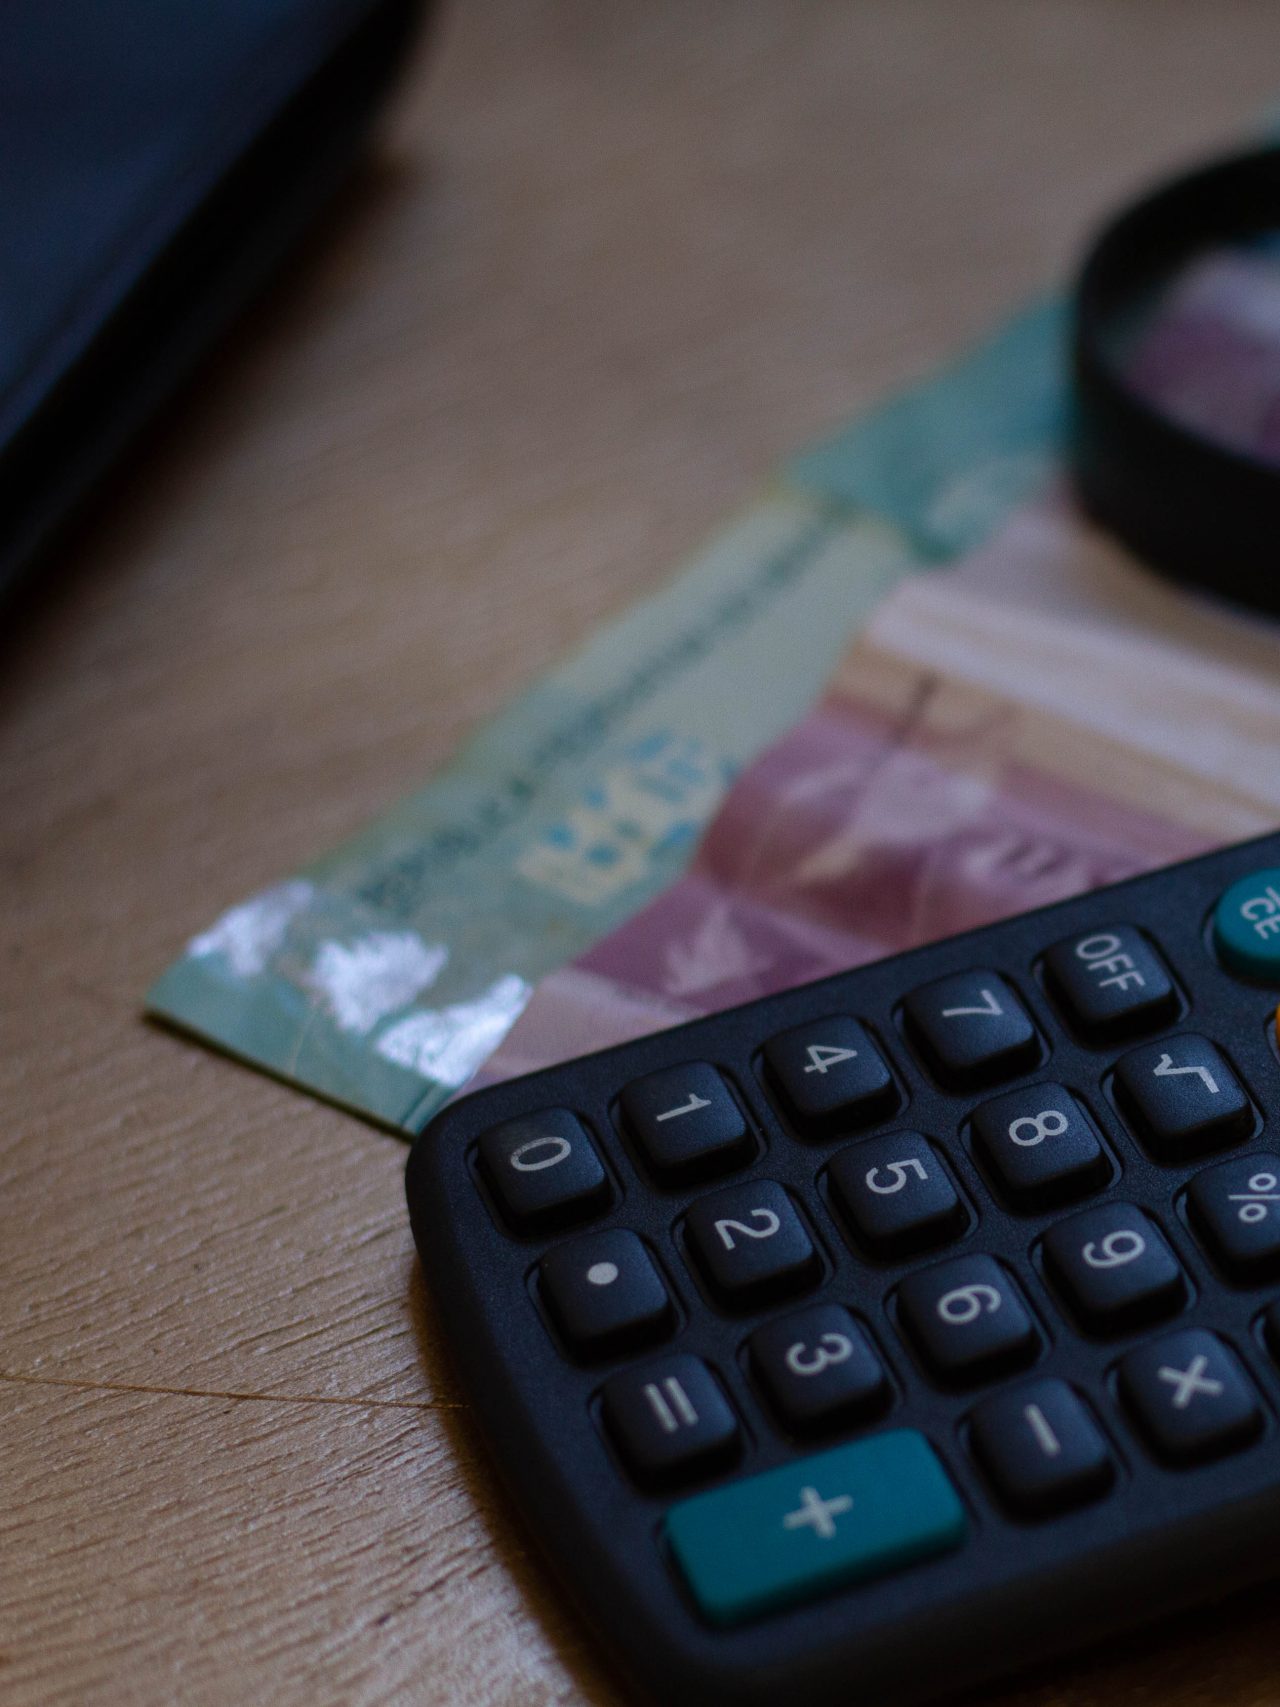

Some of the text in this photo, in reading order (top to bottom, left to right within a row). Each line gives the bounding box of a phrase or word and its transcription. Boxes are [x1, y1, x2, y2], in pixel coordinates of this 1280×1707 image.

[1076, 934, 1146, 991] OFF
[942, 989, 1005, 1017] 7
[803, 1045, 858, 1074] 4
[656, 1093, 712, 1122] 1
[1008, 1109, 1069, 1147] 8
[510, 1136, 572, 1172] 0
[865, 1158, 929, 1194] 5
[714, 1208, 781, 1250] 2
[1083, 1230, 1146, 1268] 9
[938, 1284, 1002, 1323] 6
[787, 1333, 854, 1375] 3
